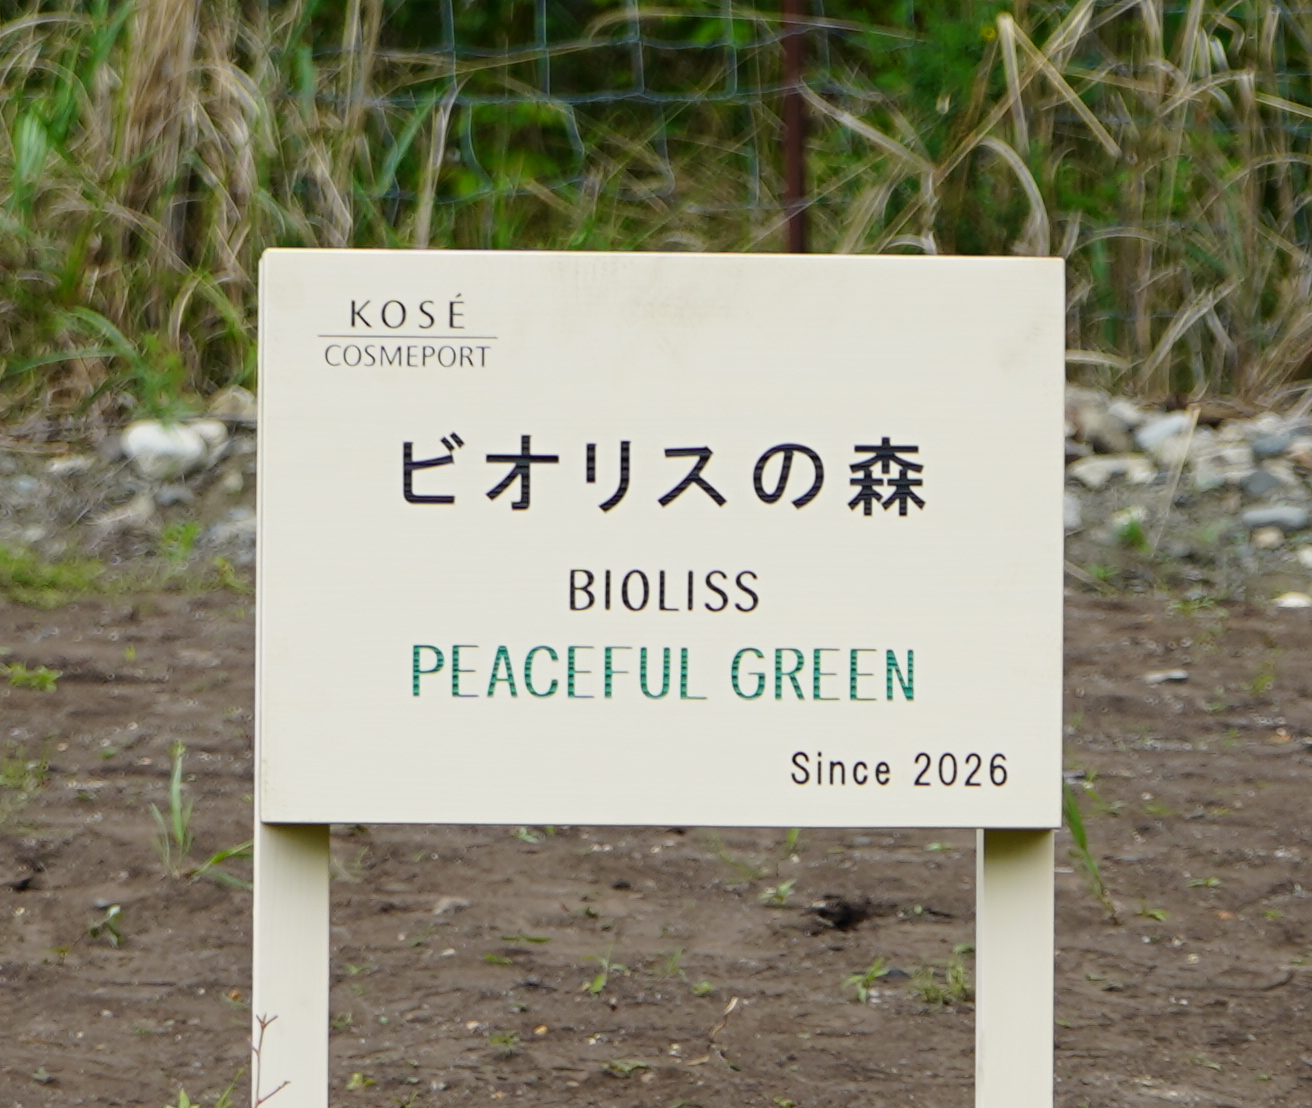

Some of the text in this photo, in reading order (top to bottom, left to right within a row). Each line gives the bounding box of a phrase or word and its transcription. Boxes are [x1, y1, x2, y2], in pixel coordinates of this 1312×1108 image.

[350, 293, 465, 329] KOSÉ
[324, 344, 491, 368] COSMEPORT
[402, 432, 927, 517] ビオリスの森
[569, 568, 760, 613] BIOLISS
[412, 645, 915, 702] PEACEFUL GREEN
[790, 751, 1008, 787] Since 2026
